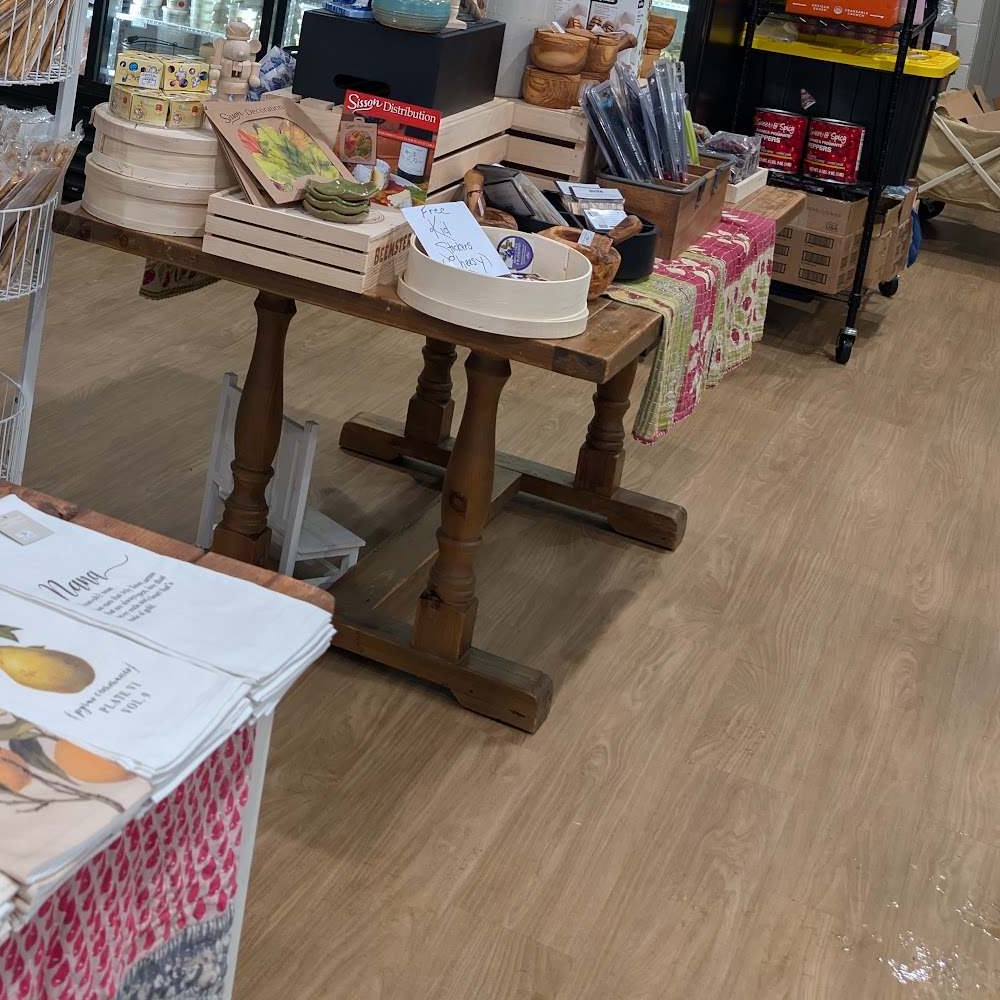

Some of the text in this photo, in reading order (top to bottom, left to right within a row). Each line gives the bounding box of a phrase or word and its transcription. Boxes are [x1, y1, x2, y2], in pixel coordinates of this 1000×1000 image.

[243, 104, 285, 116] Décoration
[347, 93, 436, 124] Sisson Distribution
[779, 122, 795, 134] Spicy
[830, 132, 847, 144] Spicy
[808, 141, 832, 153] PEPPERS
[420, 205, 450, 218] Free
[428, 216, 452, 239] Kid
[825, 224, 838, 232] USA
[38, 554, 130, 602] Nana
[99, 689, 130, 714] PLATE
